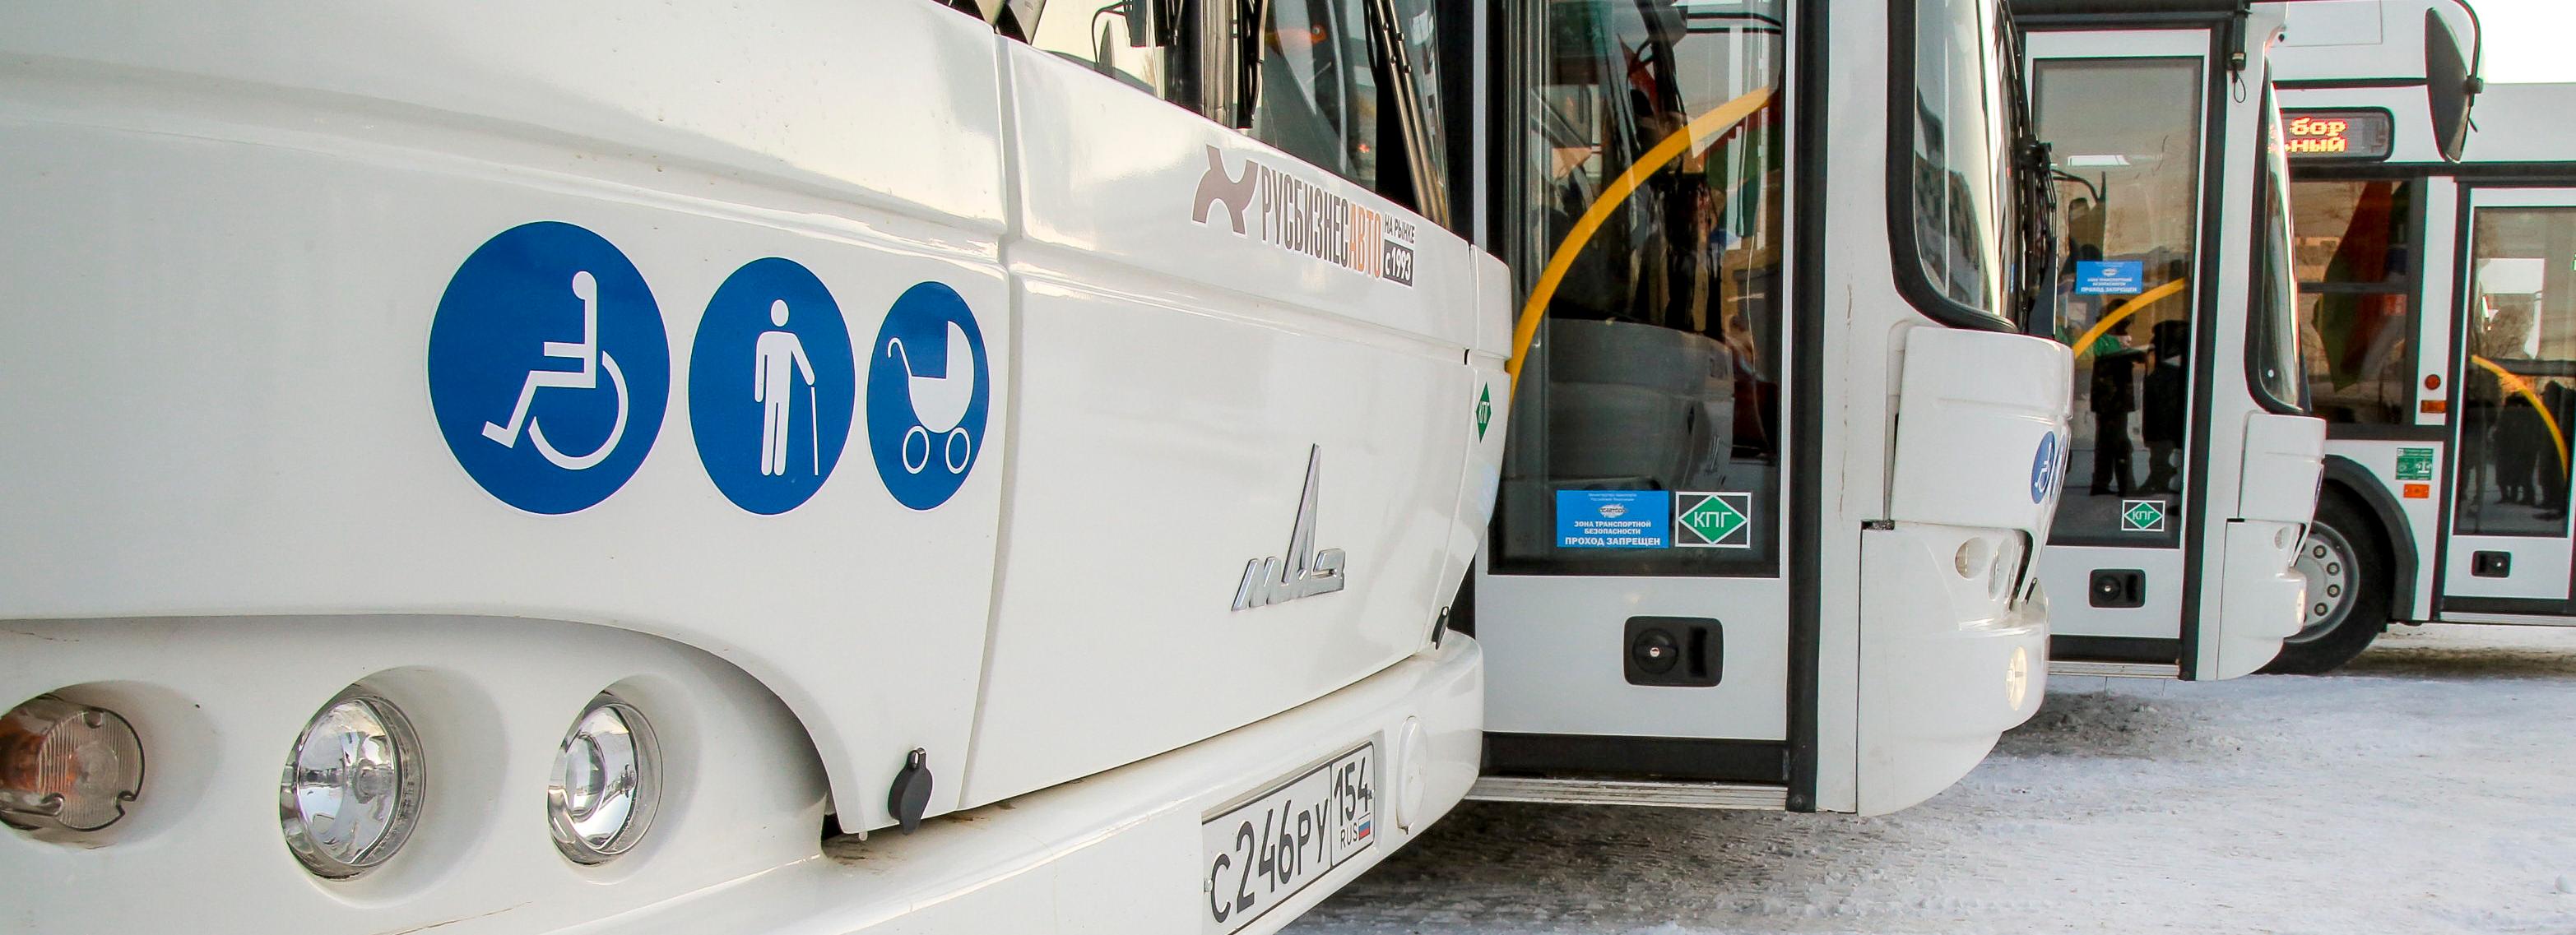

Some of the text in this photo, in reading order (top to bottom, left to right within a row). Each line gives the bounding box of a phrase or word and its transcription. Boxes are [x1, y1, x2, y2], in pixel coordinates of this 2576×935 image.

[2289, 117, 2346, 137] бор
[1260, 164, 1382, 279] РУСБИЗНЕСАВТО
[1385, 214, 1415, 244] НА РЫНКЕ
[1595, 519, 1652, 528] ТРАНСПОРТНОЙ
[1694, 511, 1733, 528] КПГ
[2132, 511, 2155, 521] КПГ
[1565, 537, 1661, 546] ПРОХОД ЗАПРЕЩЕН
[1334, 756, 1369, 826] 154
[1340, 822, 1358, 850] RUS
